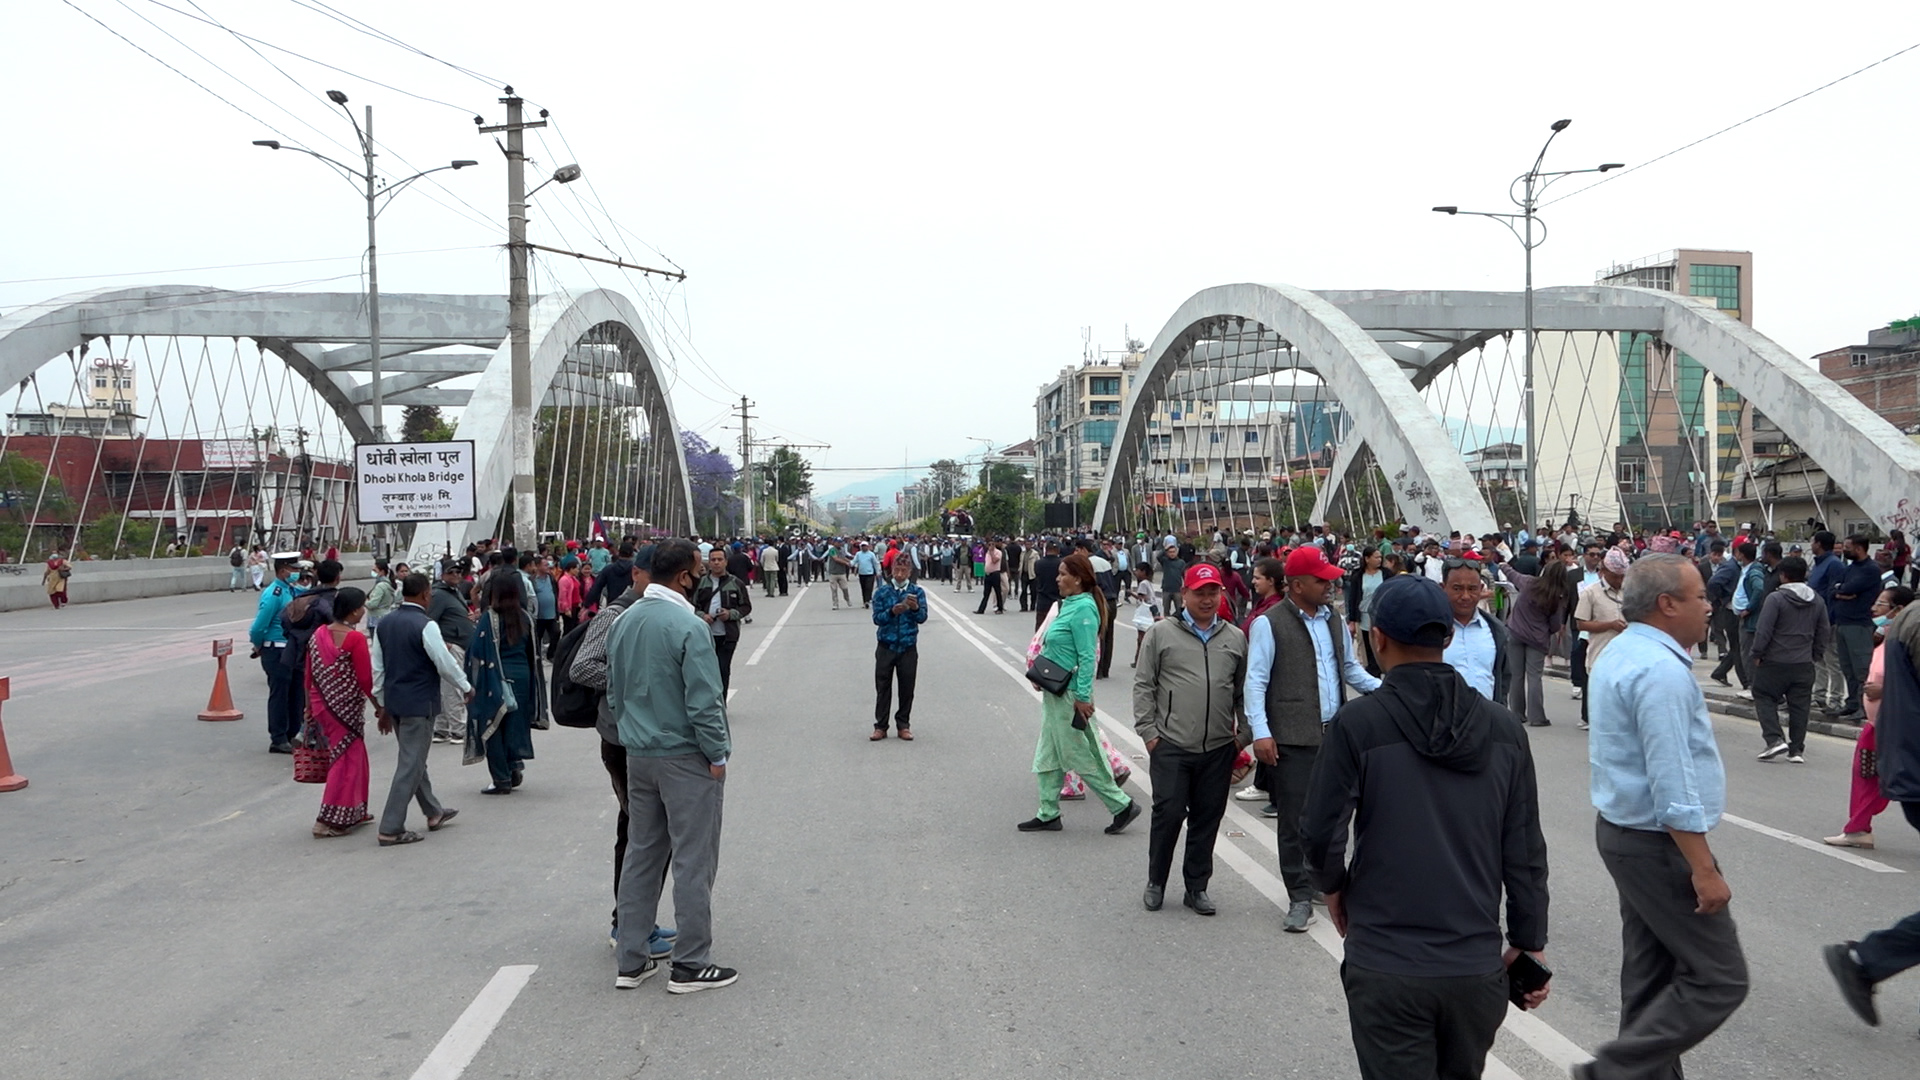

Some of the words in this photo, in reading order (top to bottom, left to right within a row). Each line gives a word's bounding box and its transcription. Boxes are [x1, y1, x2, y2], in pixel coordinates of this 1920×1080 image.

[399, 447, 432, 466] खोला
[436, 450, 461, 468] पुल
[363, 473, 396, 484] Dhobi
[399, 472, 426, 483] Khola
[428, 471, 465, 484] Bridge
